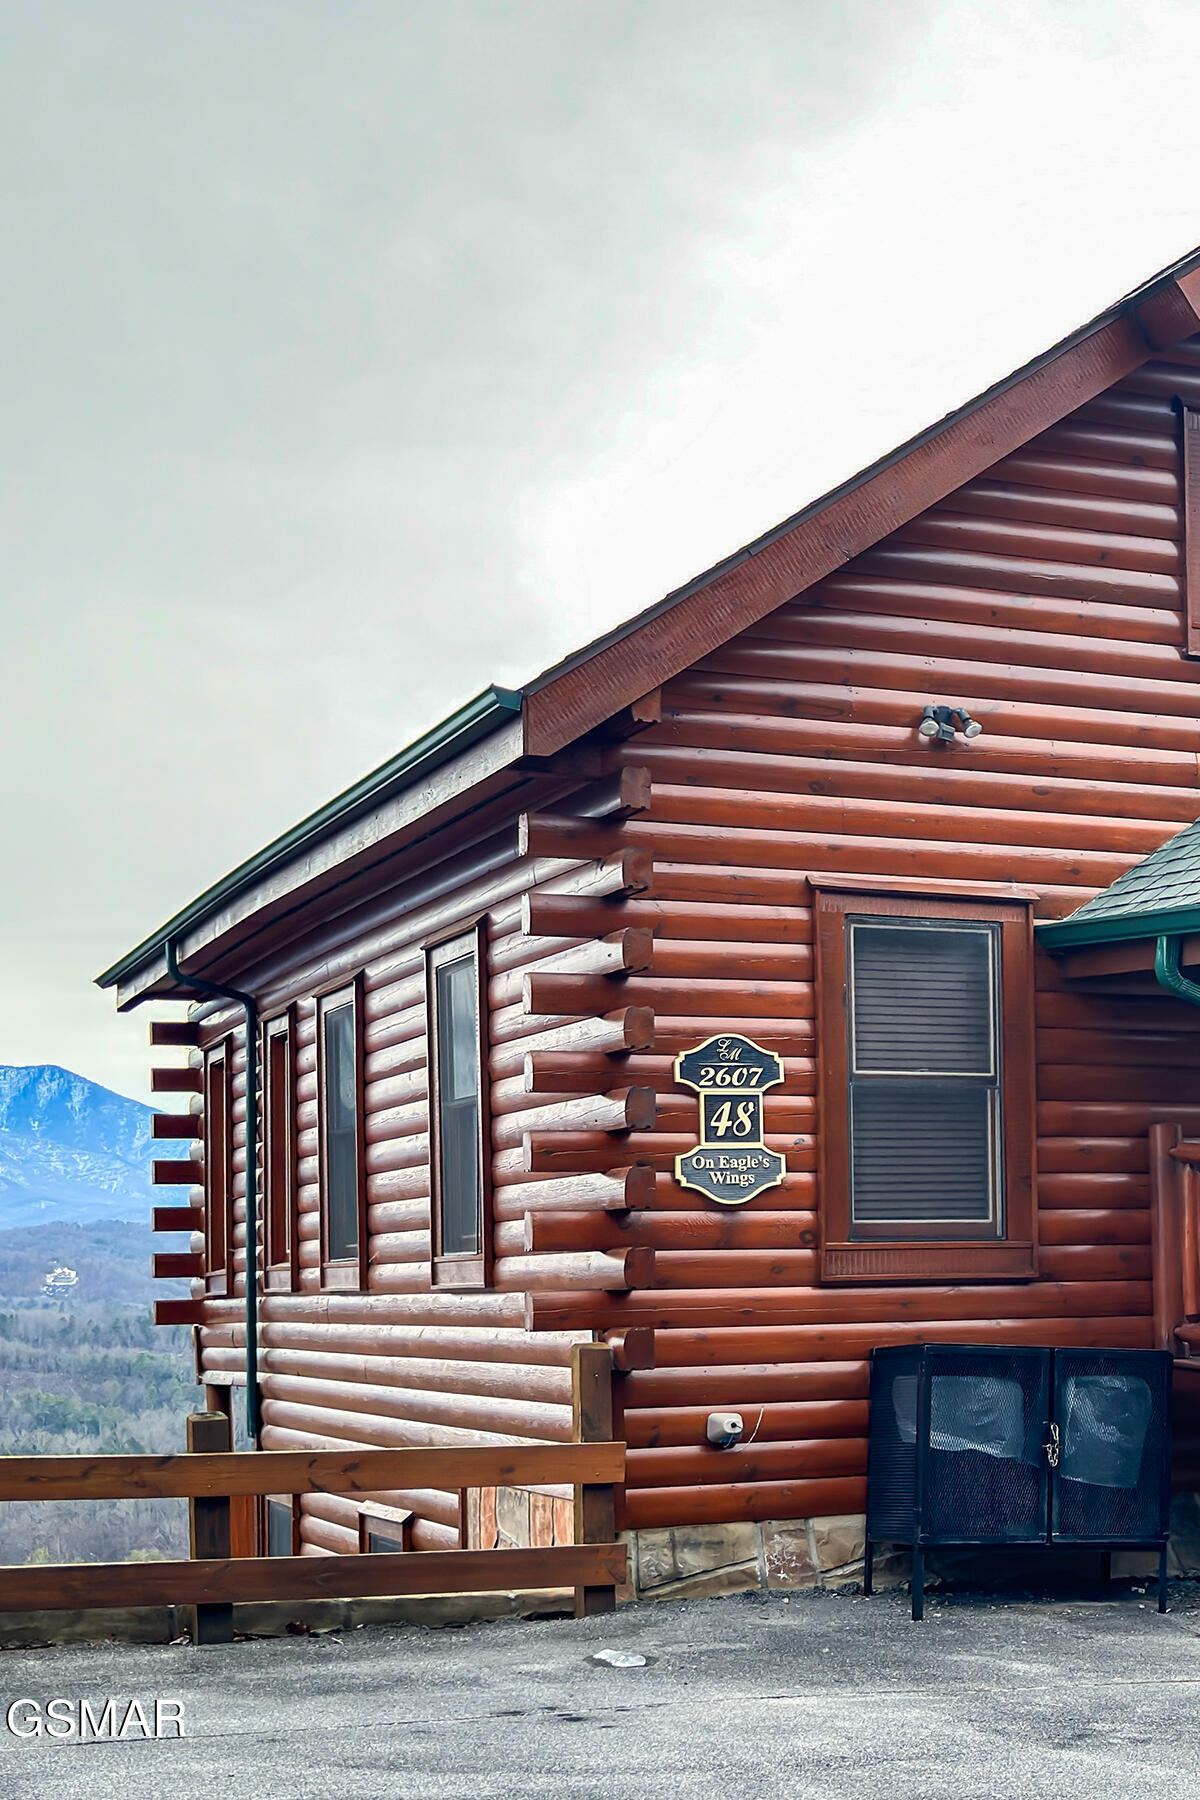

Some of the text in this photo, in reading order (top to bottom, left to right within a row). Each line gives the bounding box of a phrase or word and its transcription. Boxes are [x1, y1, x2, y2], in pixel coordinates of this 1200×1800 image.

[698, 1067, 763, 1087] 2607
[710, 1101, 755, 1137] 48
[691, 1155, 770, 1171] On Eagle's
[709, 1171, 755, 1188] Wings
